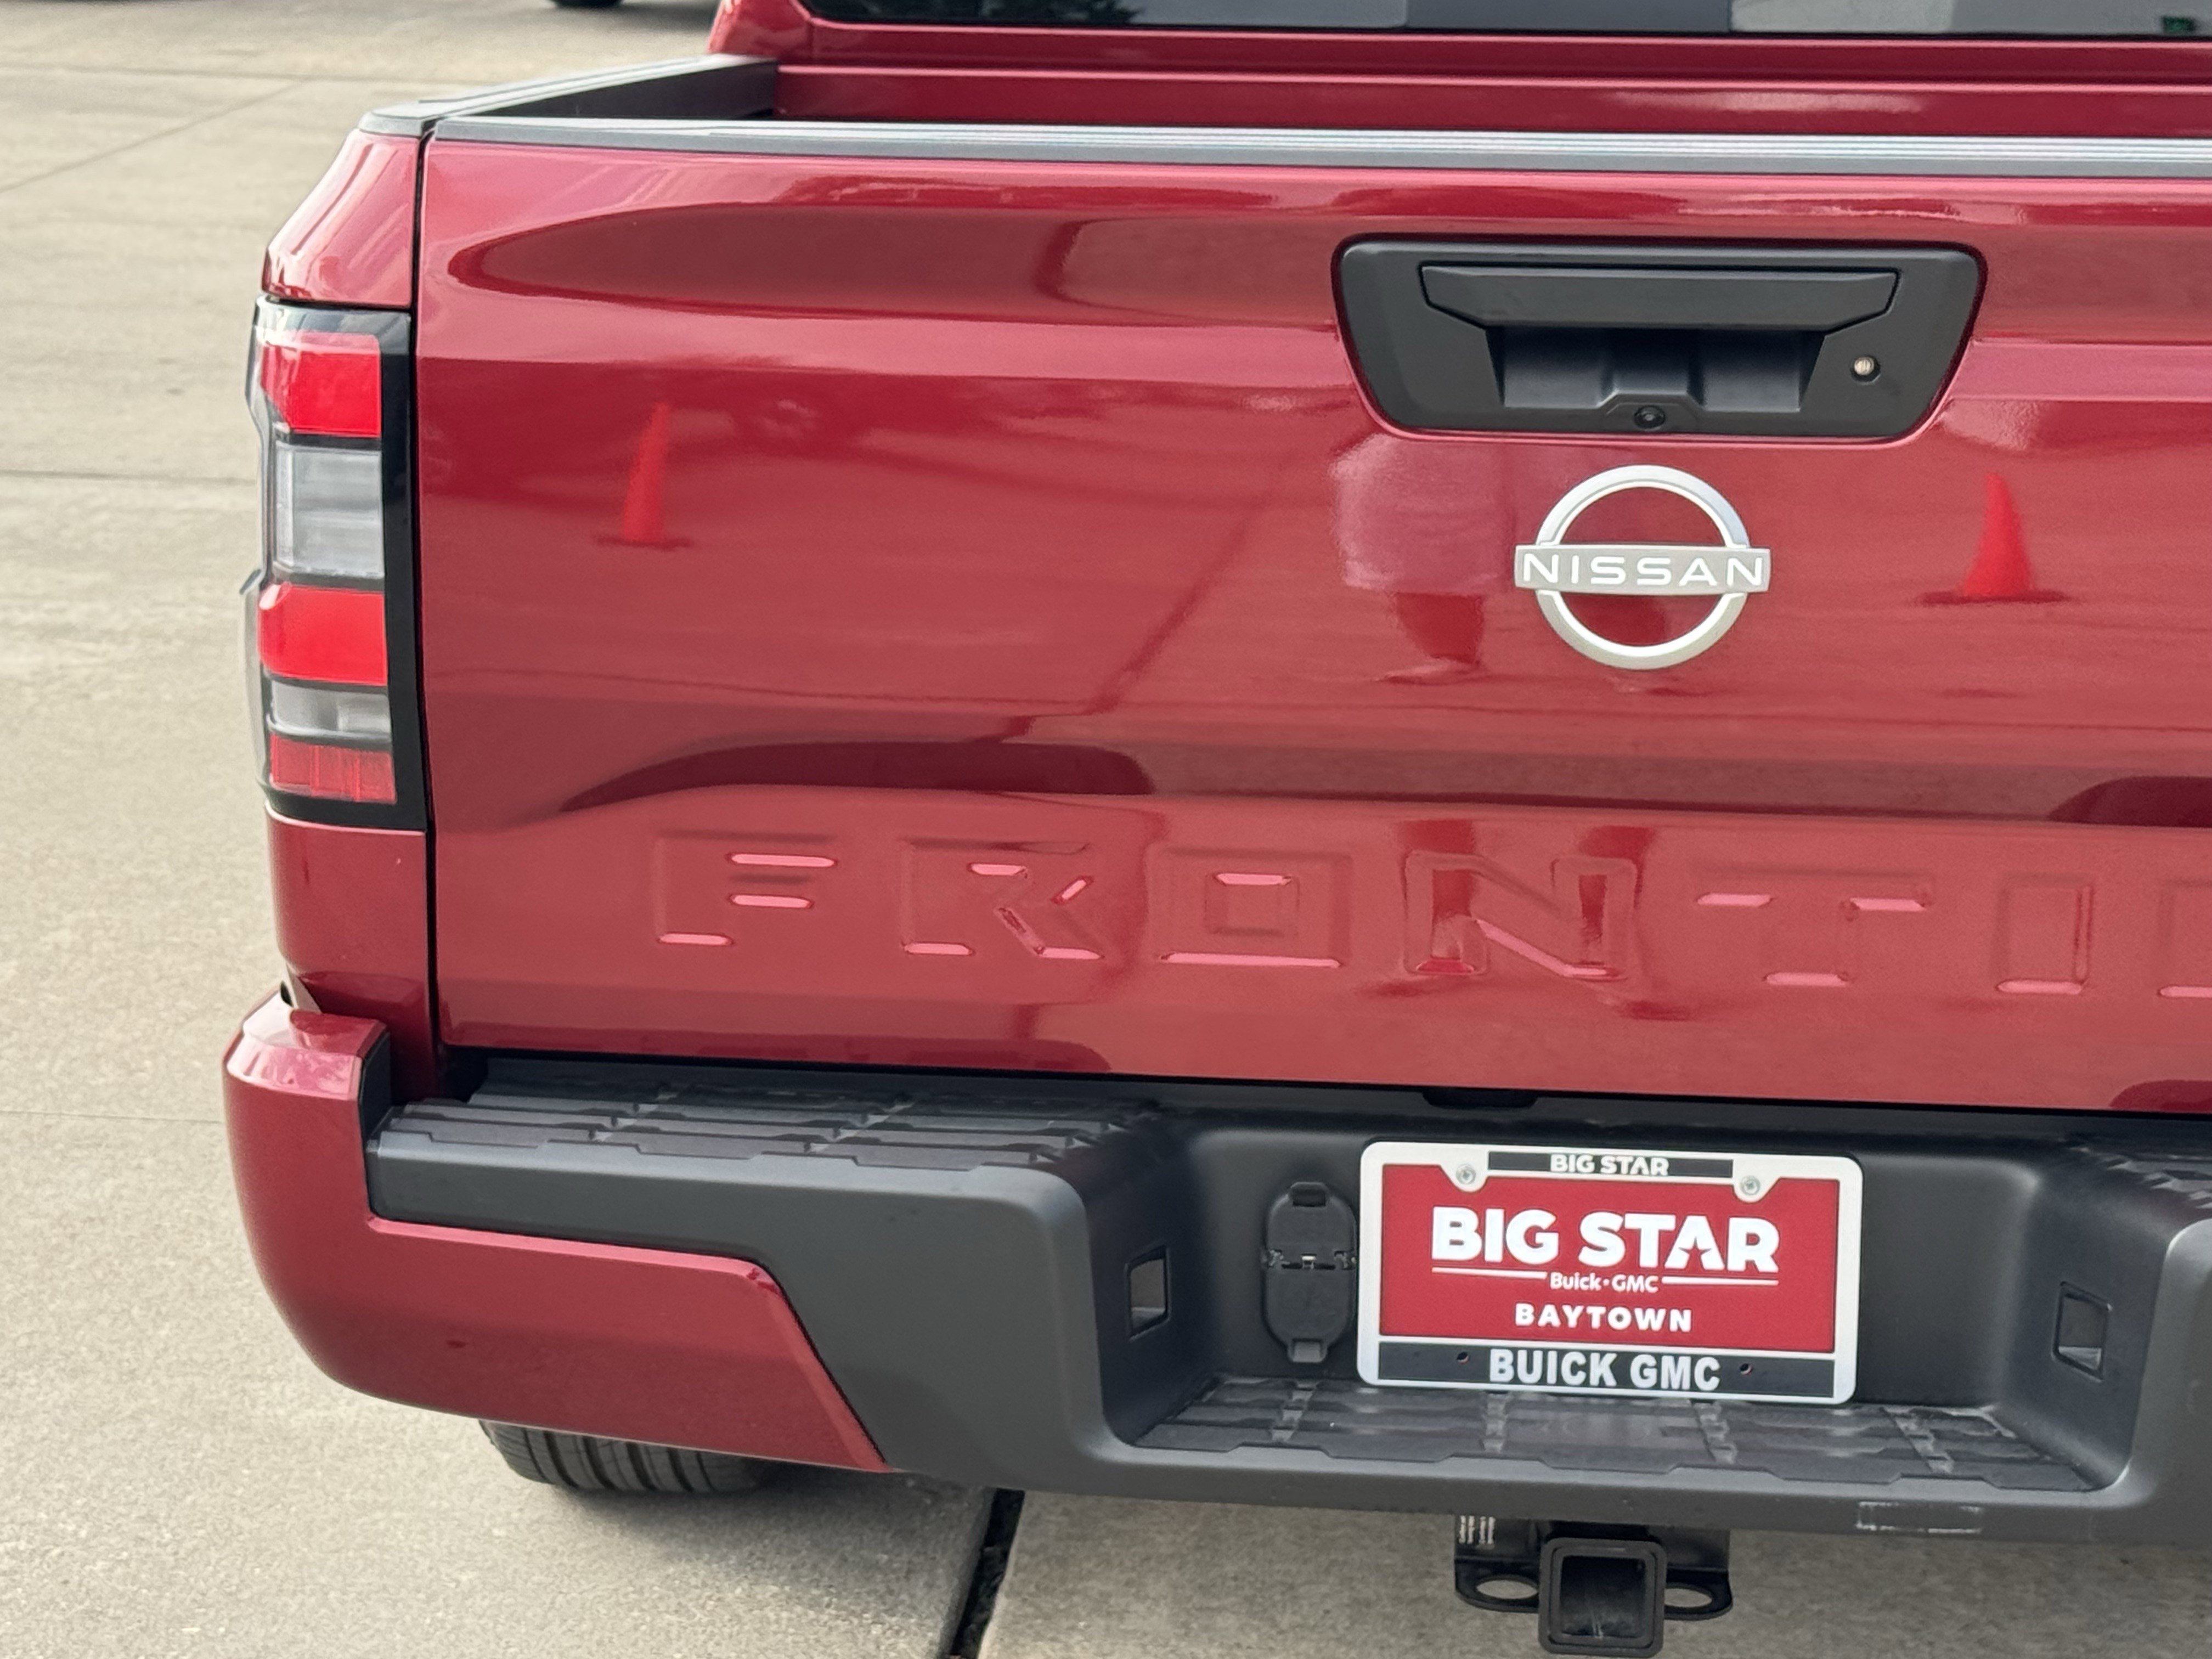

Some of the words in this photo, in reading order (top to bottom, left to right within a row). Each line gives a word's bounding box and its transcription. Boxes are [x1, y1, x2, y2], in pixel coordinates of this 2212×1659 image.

[1523, 553, 1763, 587] NISSAN
[654, 827, 2212, 1000] FRONTI
[1550, 1153, 1595, 1173] BIG
[1600, 1155, 1669, 1176] STAR
[1431, 1206, 1559, 1265] BIG
[1578, 1211, 1780, 1273] STAR
[1515, 1303, 1692, 1333] BAYTOWN
[1489, 1348, 1618, 1387] BUICK
[1630, 1353, 1721, 1391] GMC
